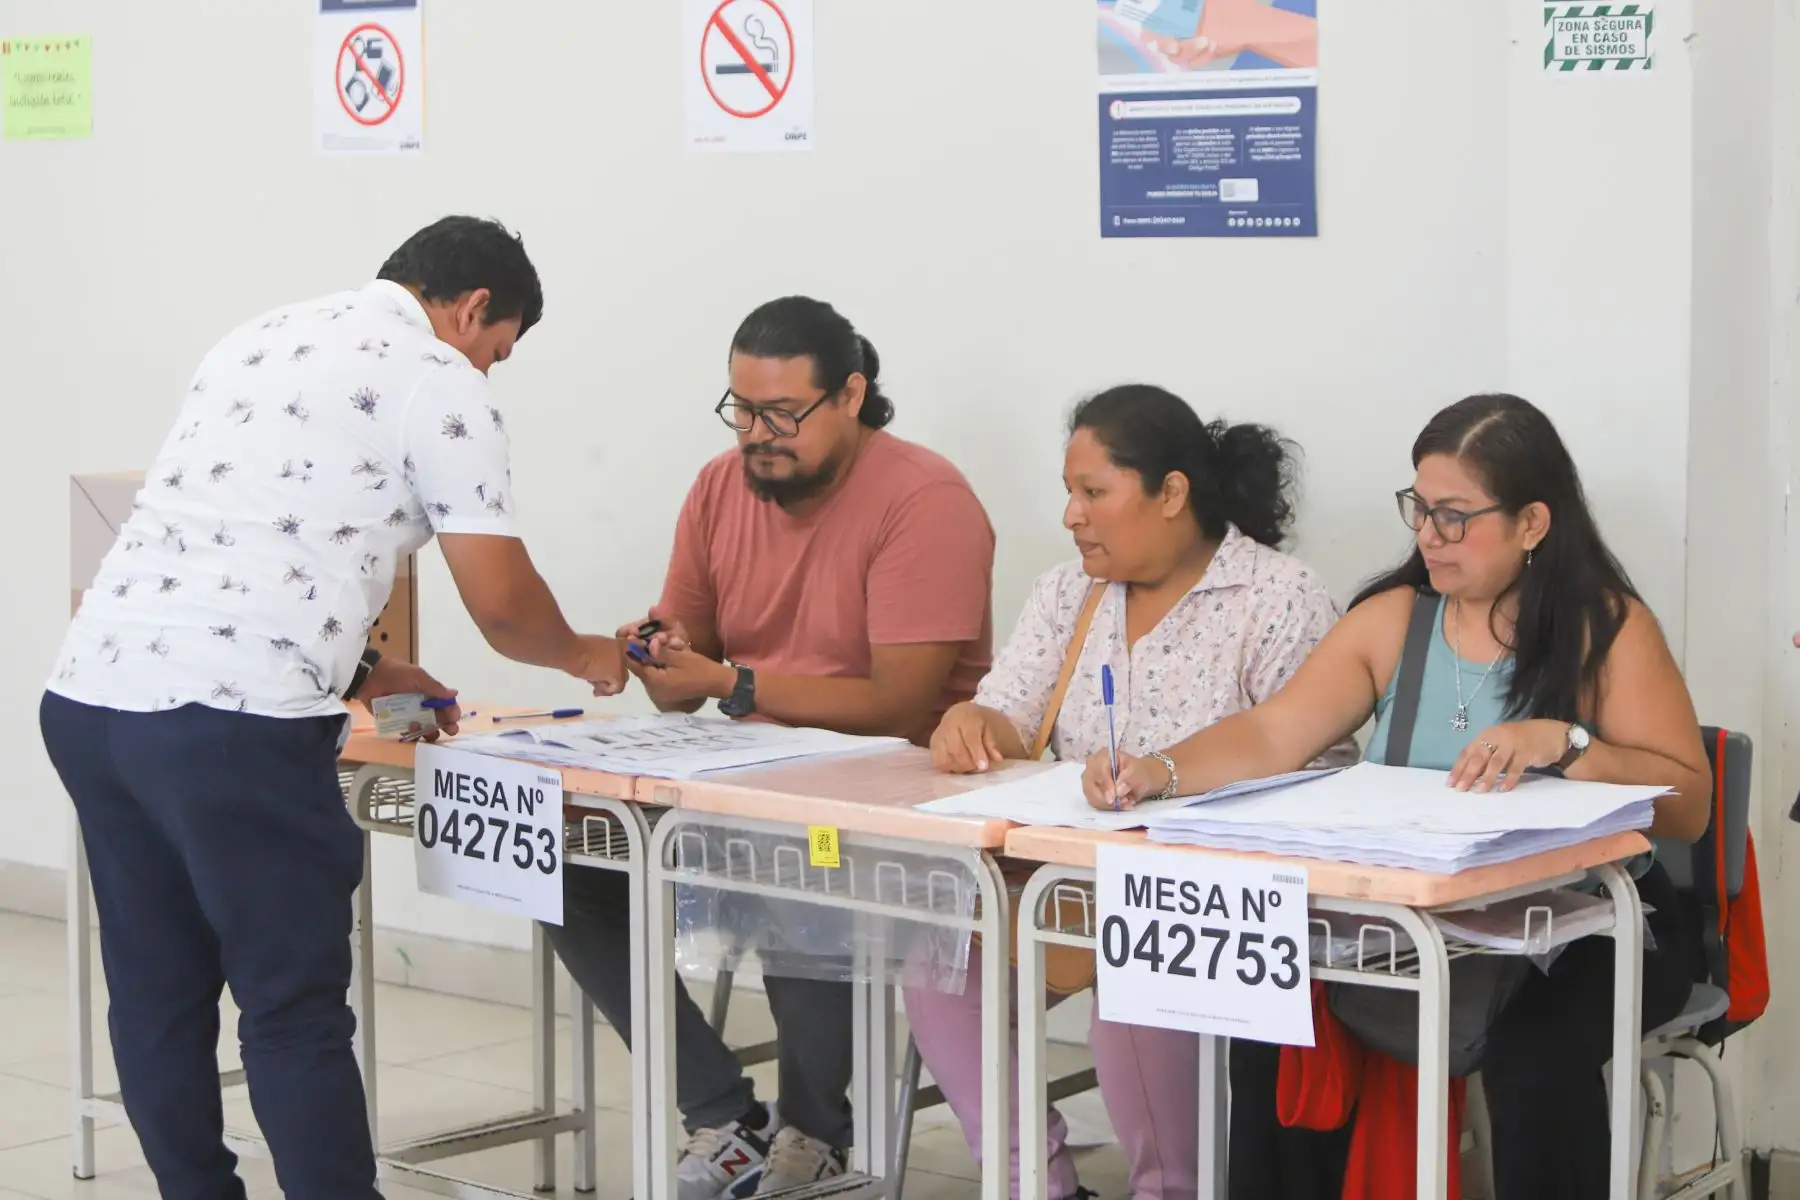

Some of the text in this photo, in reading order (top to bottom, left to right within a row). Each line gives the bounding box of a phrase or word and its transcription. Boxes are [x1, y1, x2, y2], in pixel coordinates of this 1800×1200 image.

[1558, 19, 1642, 32] ZONA SEGURA
[1572, 32, 1628, 43] EN CASO
[1565, 44, 1636, 56] DE SISMOS
[434, 768, 544, 816] MESA Nº
[418, 803, 557, 875] 042753
[1125, 873, 1282, 923] MESA Nº
[1102, 914, 1301, 990] 042753
